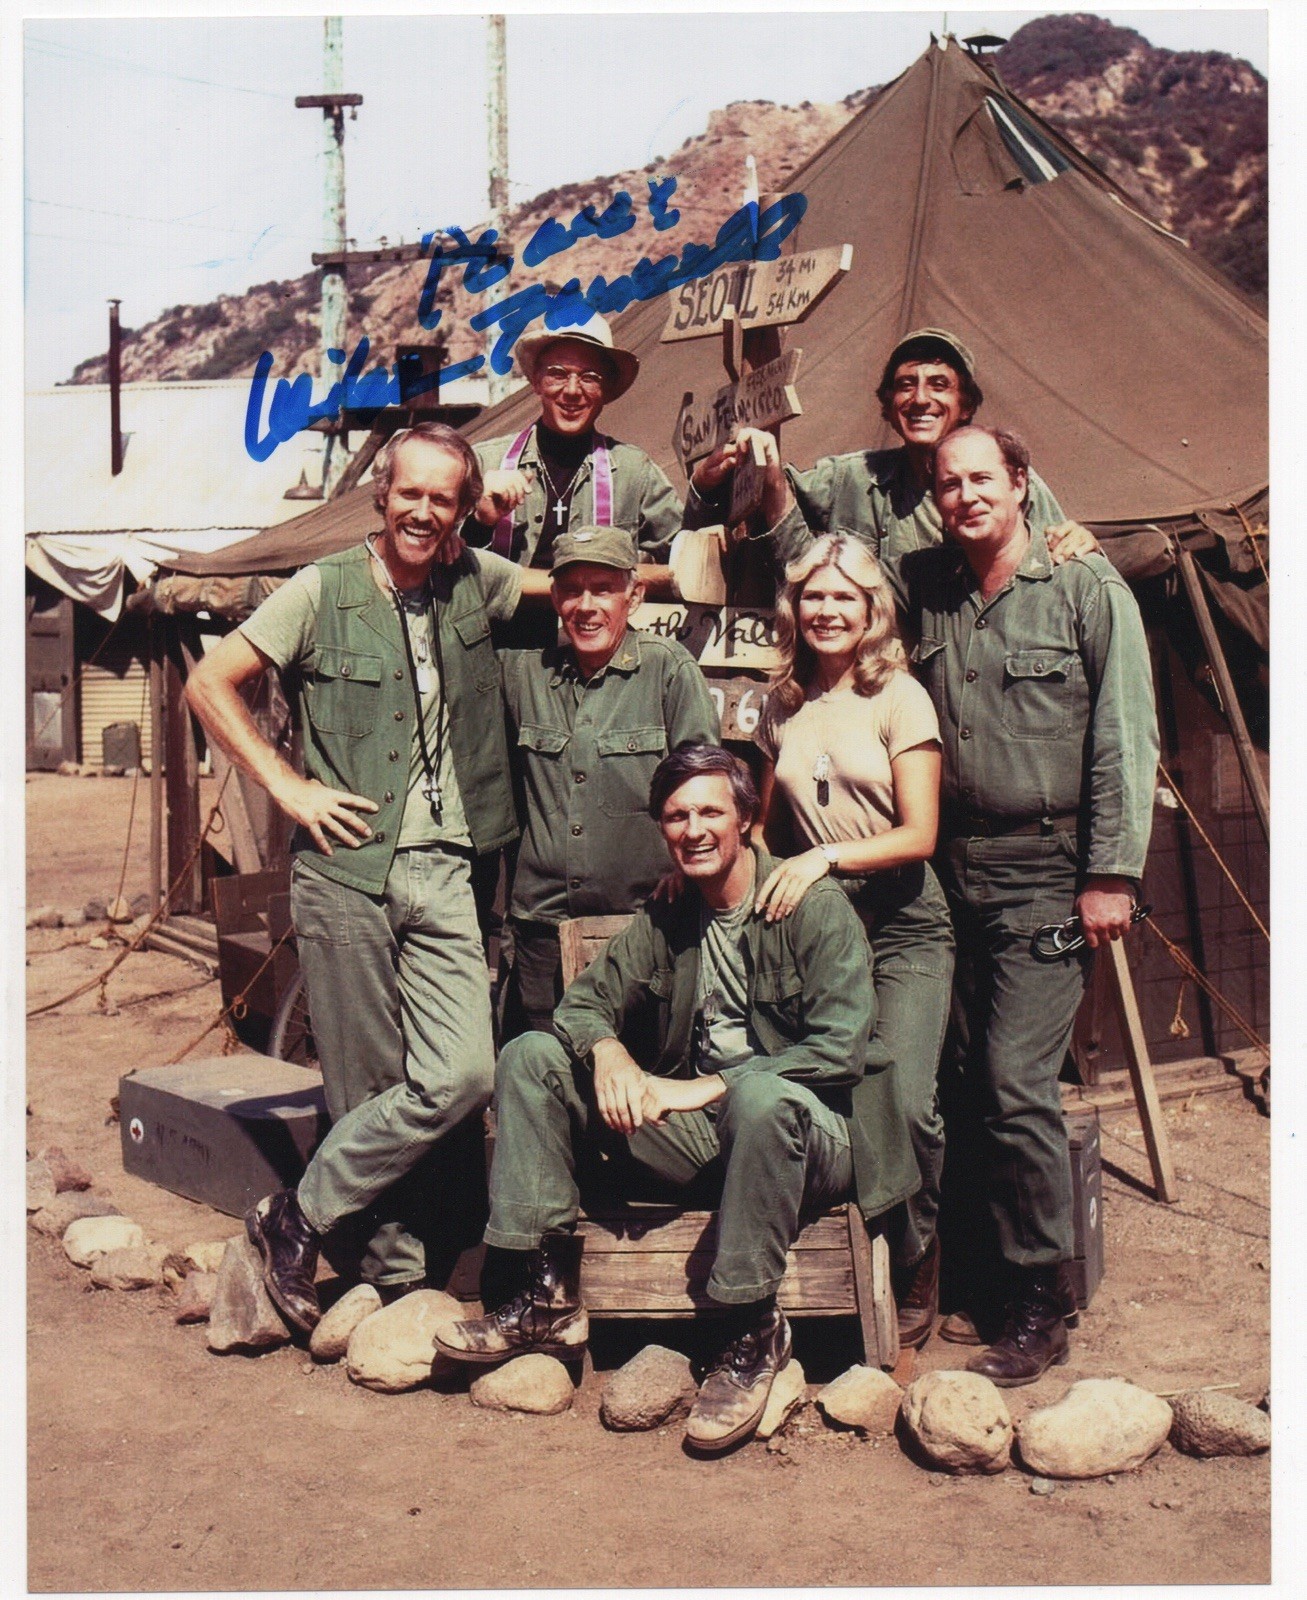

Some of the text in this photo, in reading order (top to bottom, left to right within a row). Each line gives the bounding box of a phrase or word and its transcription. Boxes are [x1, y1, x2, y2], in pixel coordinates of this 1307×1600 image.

[776, 259, 795, 284] 34
[674, 264, 758, 331] SEOUL
[766, 289, 785, 316] 54
